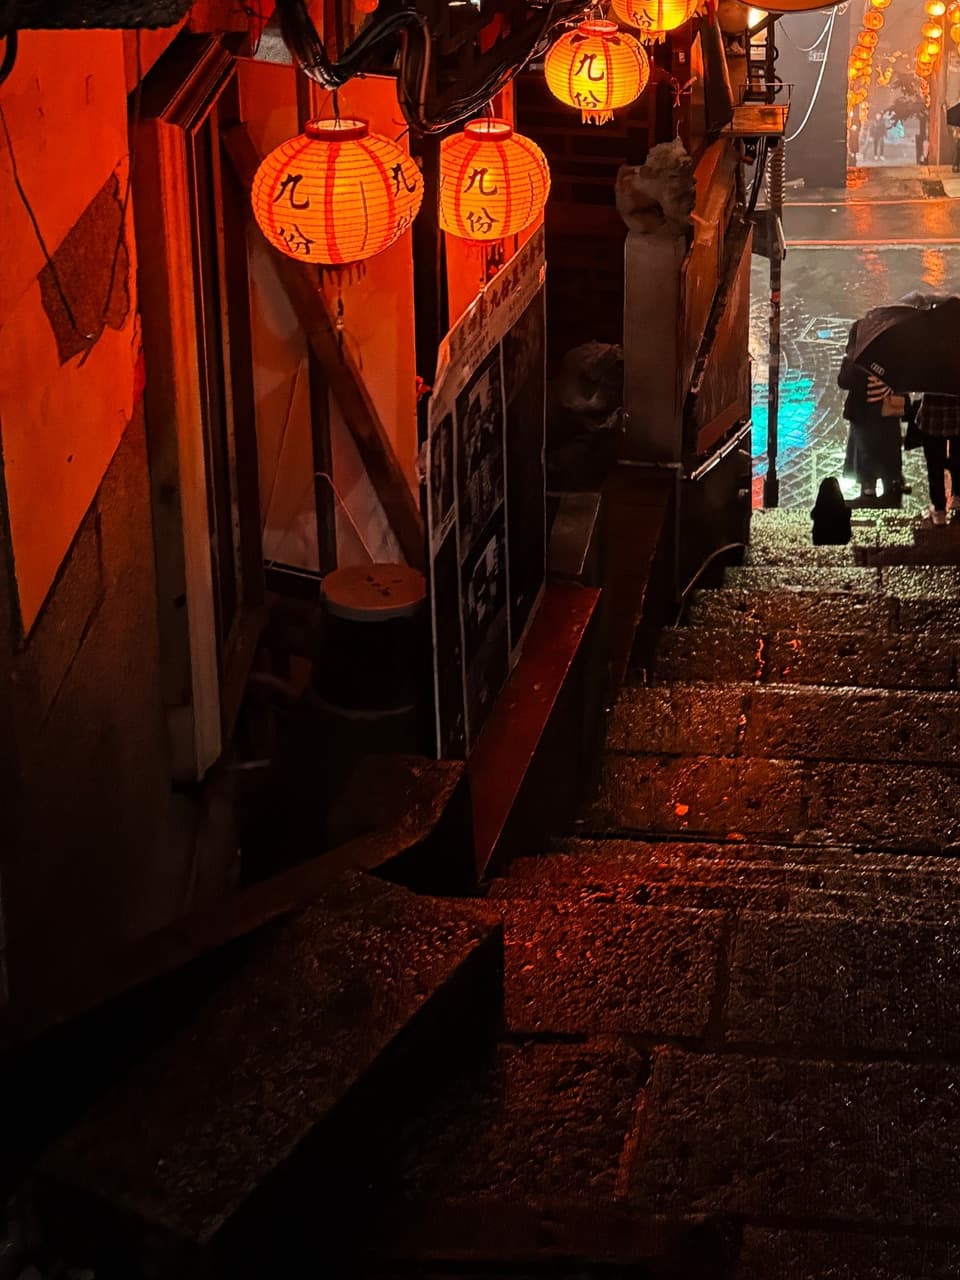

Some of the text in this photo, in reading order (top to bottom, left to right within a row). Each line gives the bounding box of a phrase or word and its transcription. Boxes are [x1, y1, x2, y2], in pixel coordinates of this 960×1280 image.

[574, 53, 604, 108] 九份
[273, 173, 316, 255] 九份
[464, 167, 499, 234] 九份
